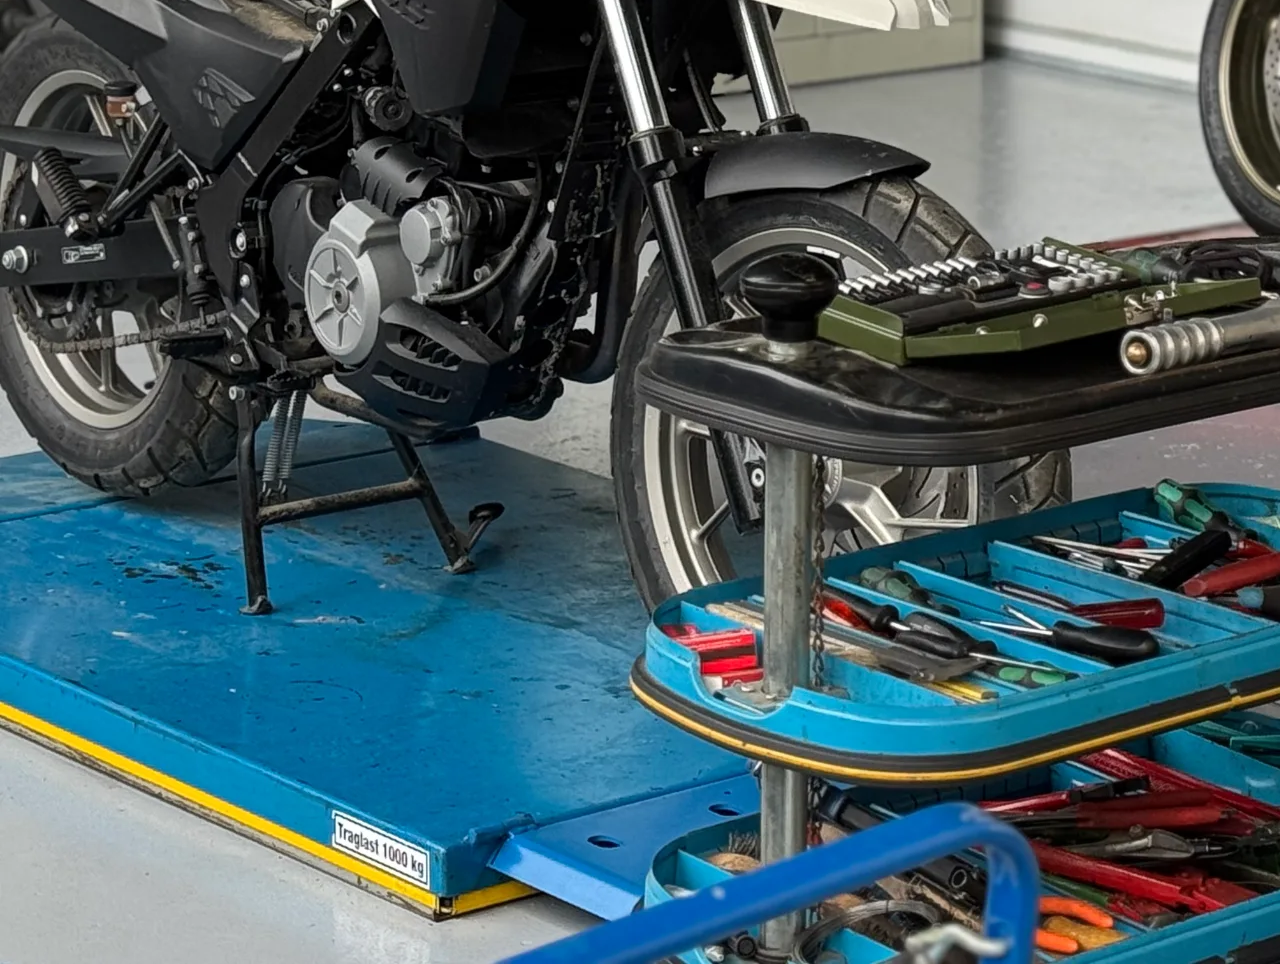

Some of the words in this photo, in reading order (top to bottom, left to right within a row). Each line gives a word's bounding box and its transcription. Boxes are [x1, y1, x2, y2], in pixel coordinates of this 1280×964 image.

[338, 822, 379, 855] Traglast
[383, 843, 408, 868] 1000
[411, 854, 424, 878] kg
